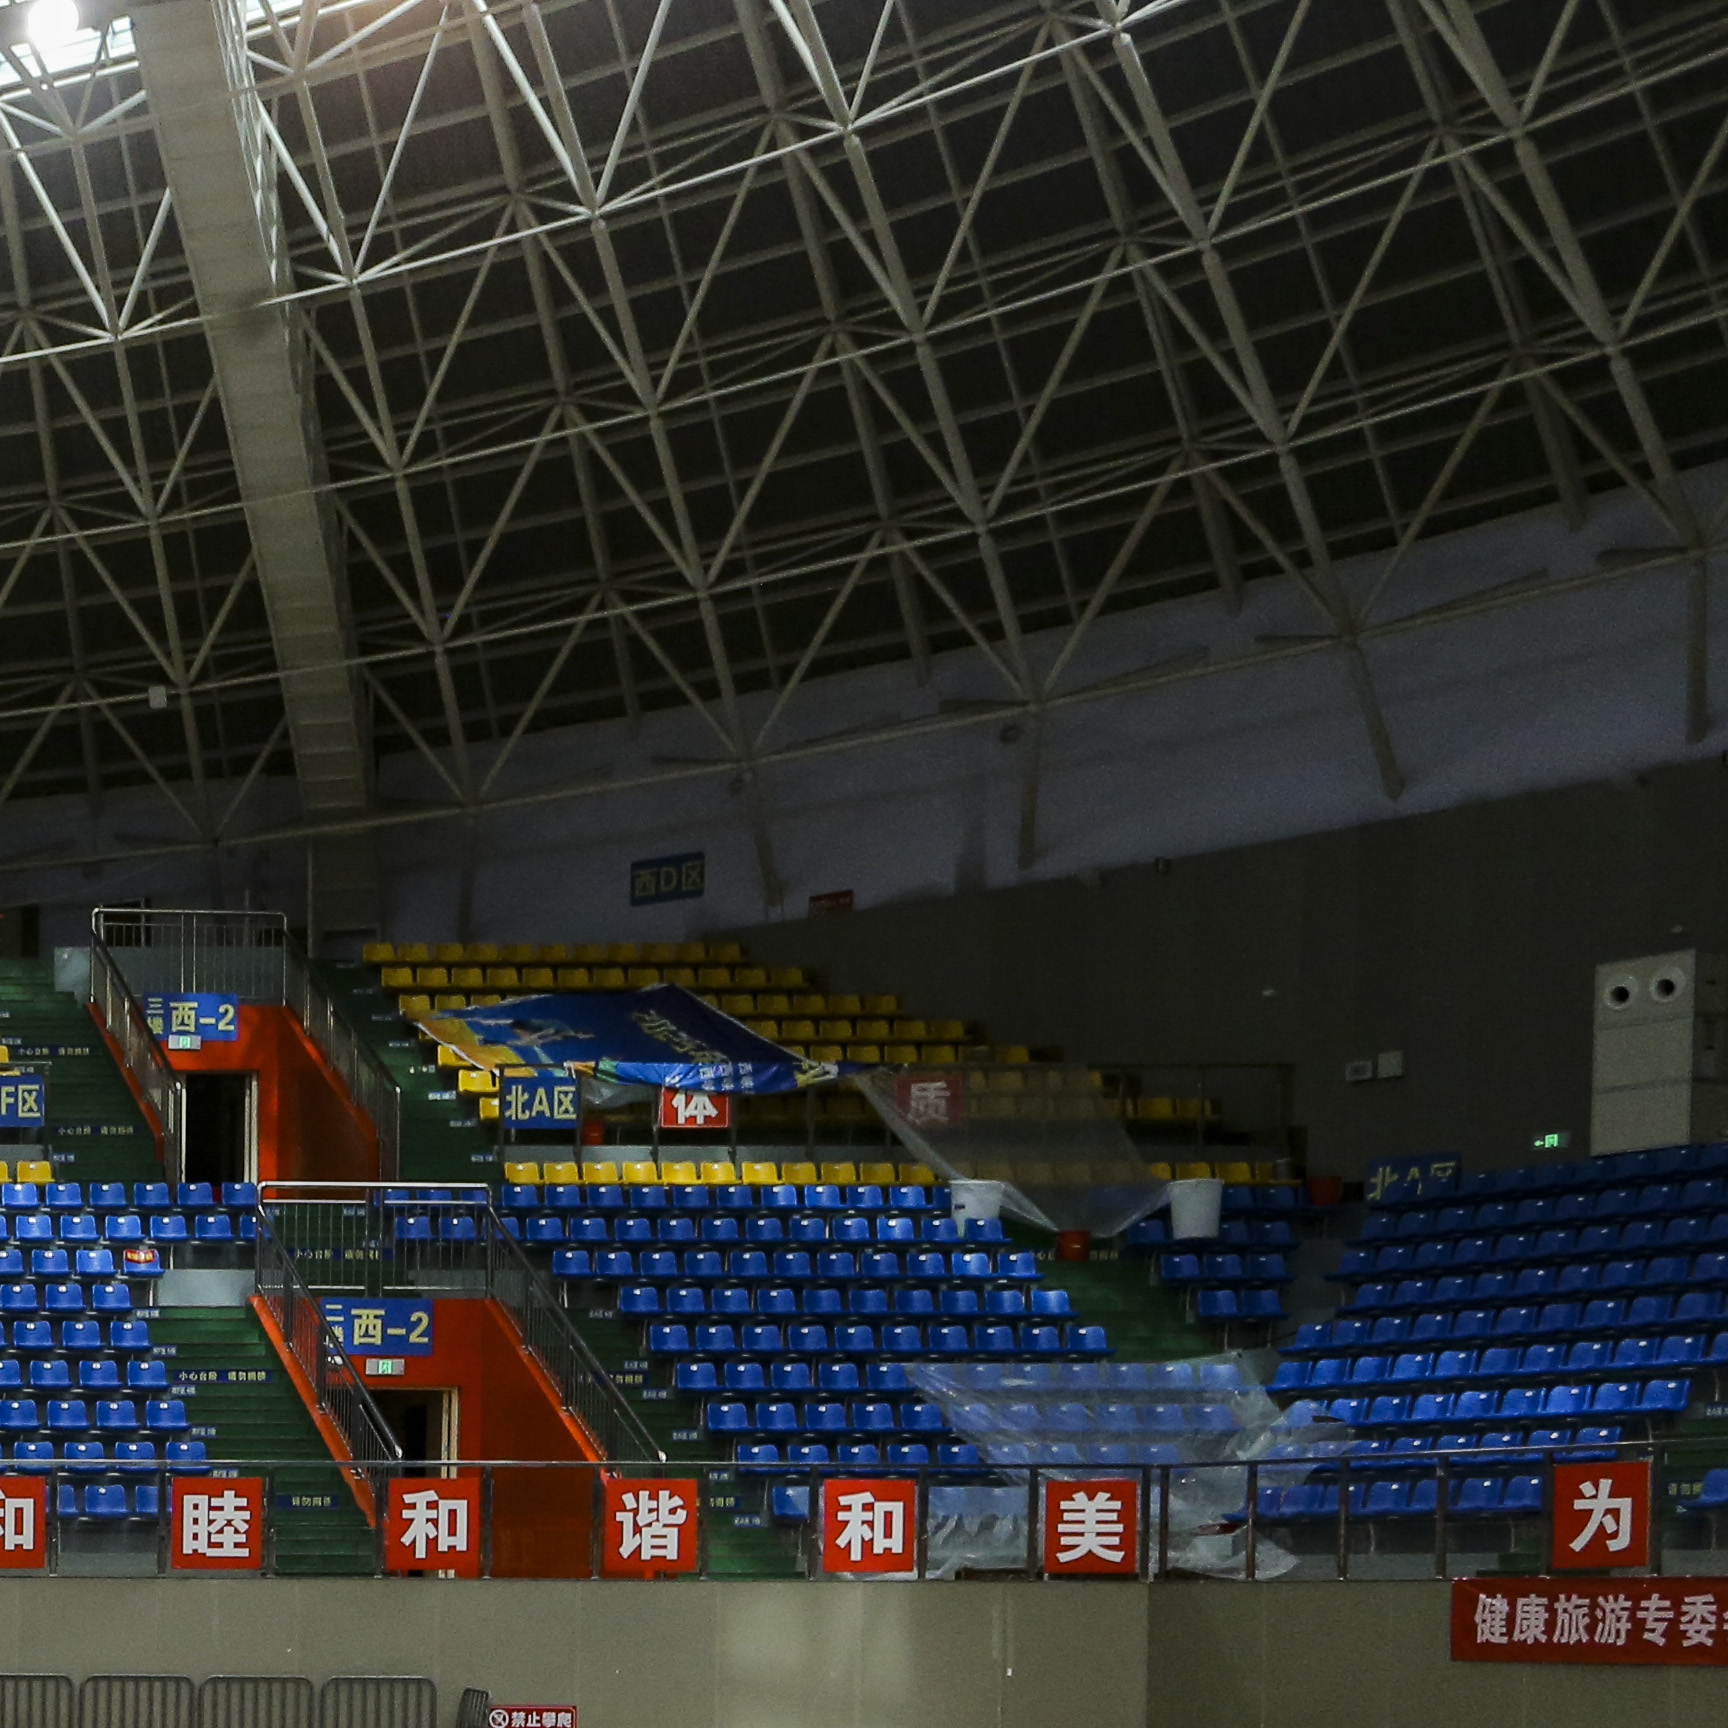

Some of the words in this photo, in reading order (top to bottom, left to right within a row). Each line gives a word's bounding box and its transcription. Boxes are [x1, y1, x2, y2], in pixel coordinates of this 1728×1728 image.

[169, 1001, 235, 1033] 西-2
[504, 1083, 576, 1121] 北A区
[671, 1089, 718, 1125] 体
[350, 1308, 430, 1346] 西-2
[183, 1491, 250, 1556] 睦
[401, 1490, 467, 1558] 和
[616, 1491, 686, 1559] 谐
[836, 1492, 903, 1560] 和
[1056, 1492, 1124, 1562] 美
[1570, 1478, 1632, 1552] 为
[1474, 1593, 1728, 1647] 健康旅游专委
[510, 1711, 573, 1728] 禁止攀爬
